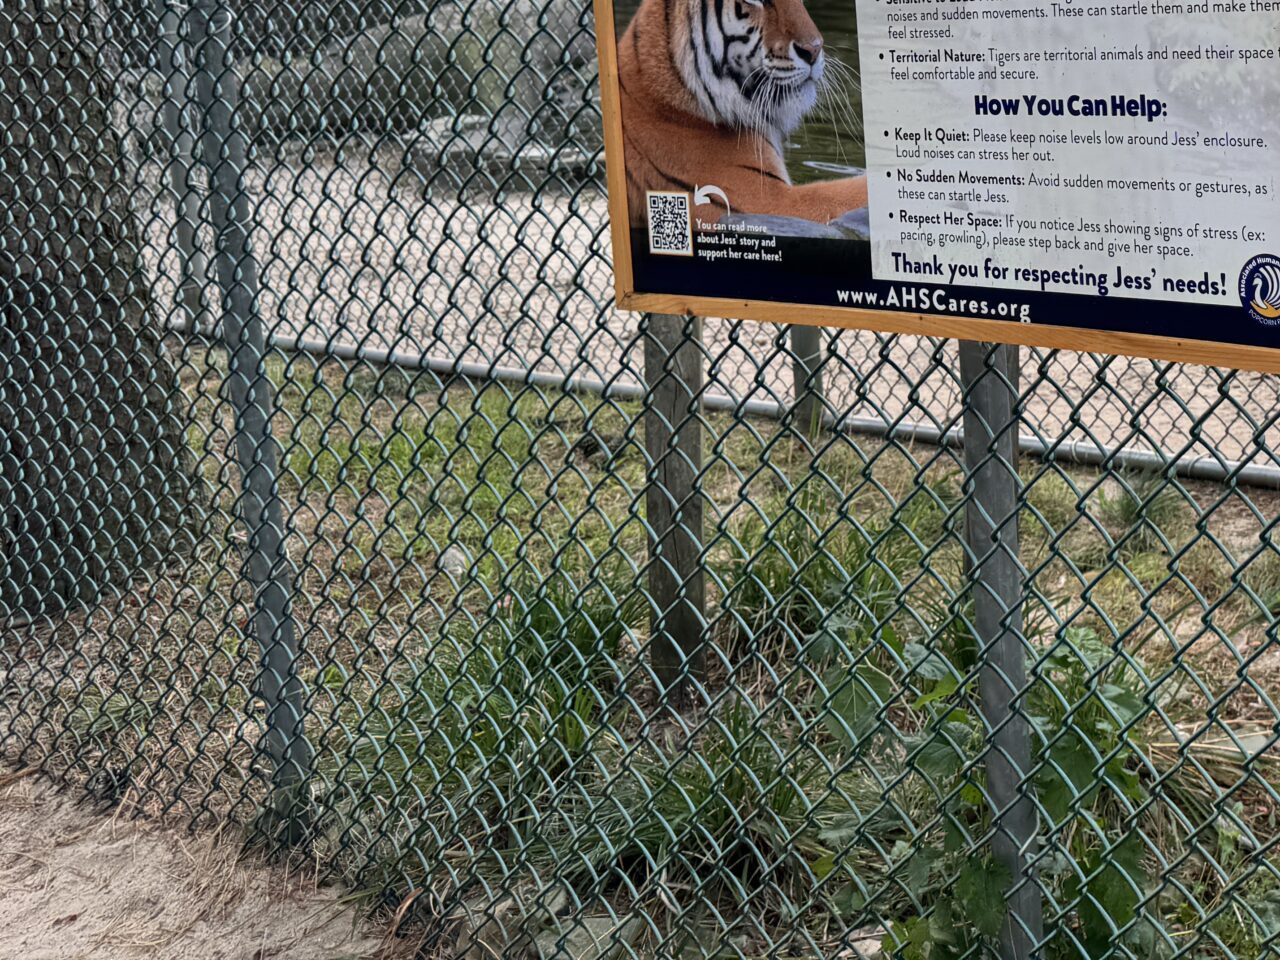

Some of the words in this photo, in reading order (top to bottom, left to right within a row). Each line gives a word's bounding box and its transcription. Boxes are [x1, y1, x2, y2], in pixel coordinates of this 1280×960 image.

[887, 8, 918, 22] noises
[920, 7, 939, 21] and
[941, 6, 979, 20] sudden
[981, 6, 1048, 19] movements.
[1050, 2, 1084, 17] These
[1086, 6, 1107, 16] can
[1110, 0, 1148, 16] startle
[1151, 0, 1183, 15] them
[887, 25, 907, 39] feel
[909, 24, 954, 39] stressed.
[888, 48, 941, 63] Territorial
[943, 48, 985, 62] Nature:
[987, 47, 1020, 66] Tigers
[1023, 52, 1041, 62] are
[1043, 46, 1097, 61] territorial
[1100, 43, 1144, 61] animals
[1146, 45, 1168, 60] and
[1172, 44, 1201, 60] need
[1205, 44, 1235, 59] their
[1238, 49, 1274, 64] space
[890, 66, 910, 80] feel
[911, 66, 975, 80] comfortable
[977, 66, 997, 80] and
[999, 70, 1038, 80] secure.
[974, 94, 1020, 116] How
[1022, 94, 1064, 116] You
[1066, 94, 1108, 116] Can
[1110, 94, 1167, 122] Help:
[894, 127, 921, 146] Keep
[923, 127, 933, 141] It
[934, 127, 970, 144] Quiet:
[972, 128, 1007, 143] Please
[1009, 128, 1036, 148] keep
[1038, 129, 1067, 144] noise
[1070, 129, 1102, 144] levels
[1104, 129, 1124, 145] low
[1127, 130, 1168, 145] around
[1171, 131, 1199, 146] Jess’
[1203, 131, 1267, 148] enclosure.
[895, 144, 920, 158] Loud
[923, 145, 955, 159] noises
[957, 150, 976, 160] can
[978, 148, 1009, 161] stress
[1011, 146, 1030, 161] her
[1032, 150, 1054, 162] out.
[896, 168, 913, 182] No
[915, 168, 955, 183] Sudden
[958, 170, 1025, 186] Movements:
[1027, 172, 1060, 187] Avoid
[1063, 173, 1103, 189] sudden
[1106, 177, 1176, 191] movements
[1178, 182, 1192, 192] or
[1195, 181, 1251, 197] gestures,
[1254, 184, 1268, 195] as
[897, 185, 925, 200] these
[927, 191, 946, 200] can
[948, 188, 982, 202] startle
[983, 188, 1009, 203] Jess.
[696, 218, 711, 231] You
[713, 223, 726, 231] can
[728, 220, 745, 232] read
[747, 224, 767, 233] more
[899, 209, 941, 228] Respect
[943, 211, 964, 226] Her
[966, 211, 1002, 232] Space:
[1005, 213, 1014, 228] If
[1016, 219, 1036, 233] you
[1039, 216, 1074, 231] notice
[1076, 217, 1101, 233] Jess
[1103, 218, 1151, 240] showing
[1153, 221, 1183, 241] signs
[1186, 222, 1200, 238] of
[1202, 226, 1238, 240] stress
[1241, 225, 1265, 242] (ex:
[697, 234, 719, 244] about
[720, 234, 738, 245] Jess’
[739, 237, 759, 250] story
[761, 236, 776, 247] and
[900, 227, 936, 246] pacing,
[938, 229, 990, 249] growling),
[992, 231, 1025, 250] please
[1028, 236, 1052, 253] step
[1054, 234, 1081, 250] back
[1083, 236, 1104, 251] and
[1107, 238, 1131, 257] give
[1133, 238, 1154, 254] her
[1156, 245, 1193, 260] space.
[698, 249, 728, 262] support
[728, 248, 742, 259] her
[744, 251, 760, 260] care
[762, 250, 782, 262] here!
[891, 251, 944, 275] Thank
[947, 263, 978, 281] you
[983, 257, 1009, 280] for
[1014, 264, 1108, 295] respecting
[1112, 265, 1156, 290] Jess’
[1162, 271, 1226, 296] needs!
[1240, 260, 1257, 297] Associated
[836, 285, 1032, 324] www.AHSCares.org
[1248, 309, 1277, 326] POPCORN
